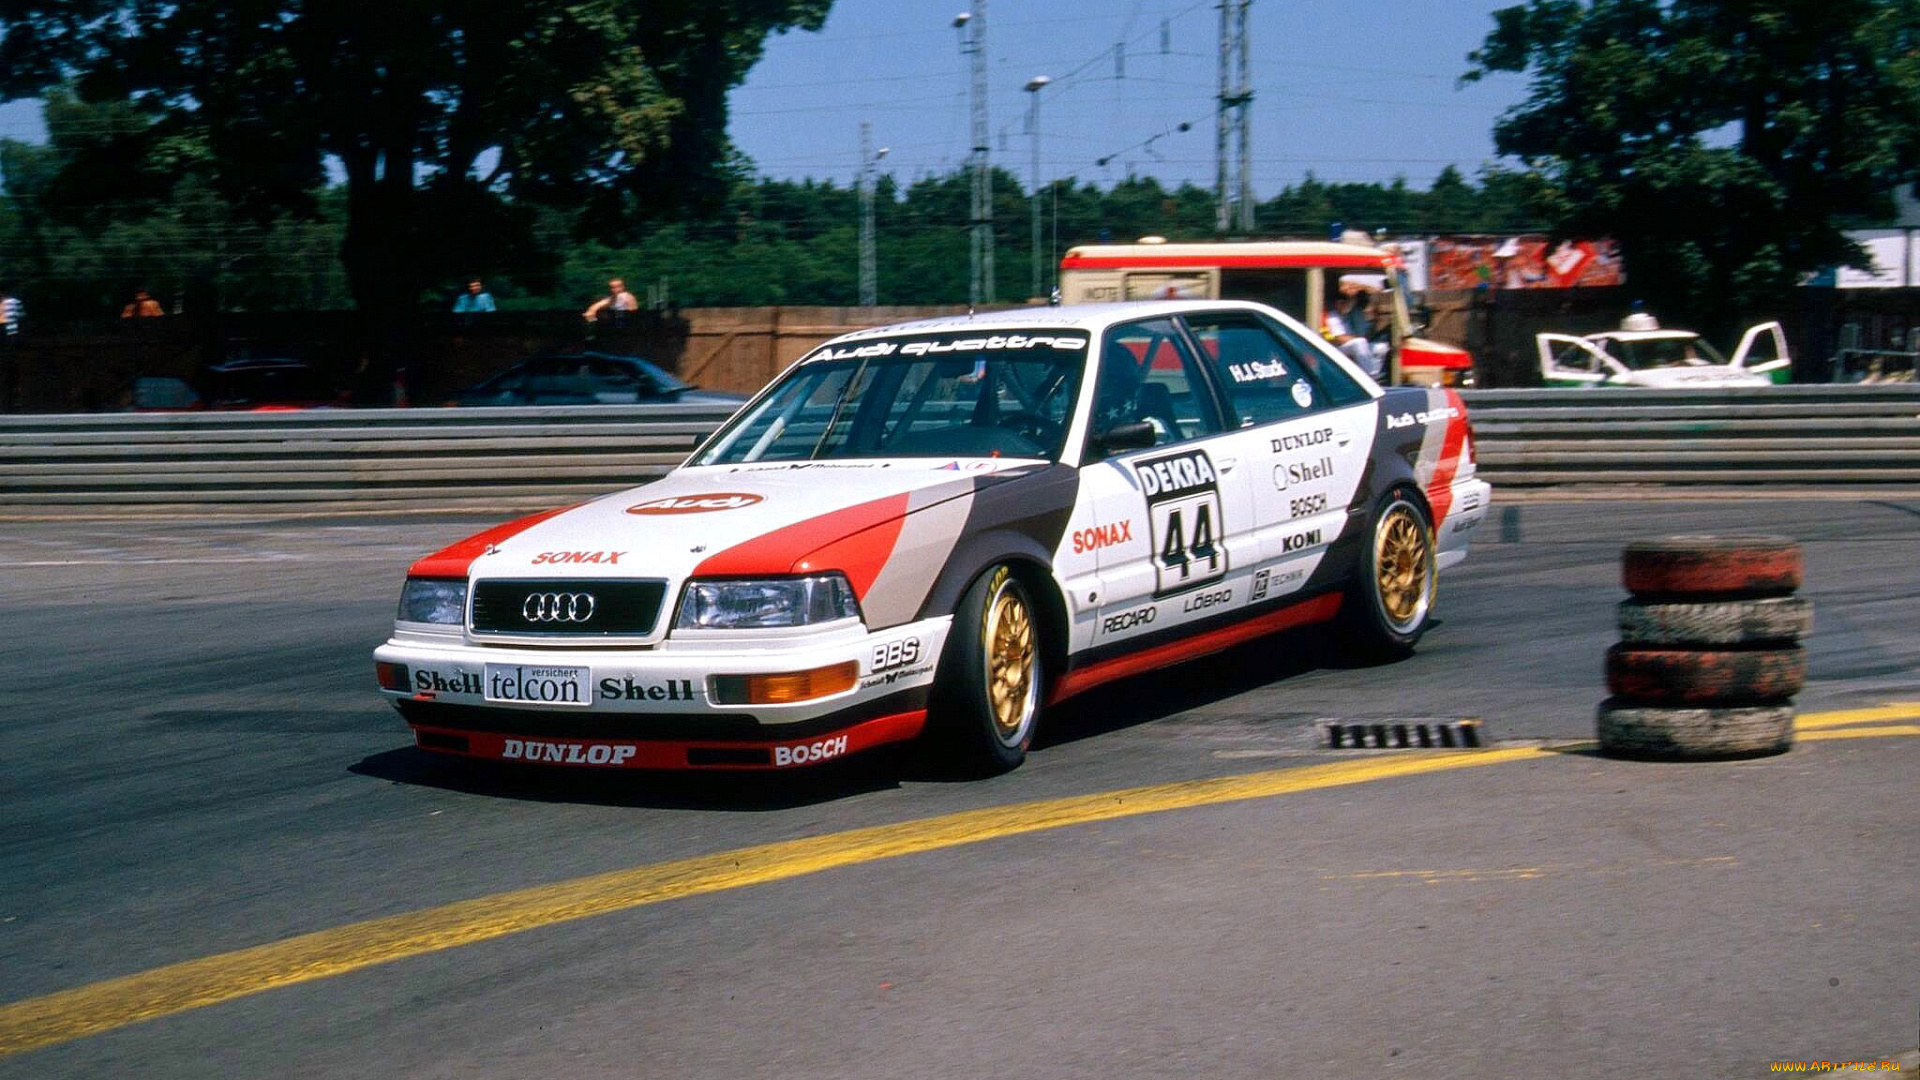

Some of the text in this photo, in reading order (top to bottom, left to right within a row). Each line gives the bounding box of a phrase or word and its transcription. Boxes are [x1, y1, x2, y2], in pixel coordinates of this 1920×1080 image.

[799, 335, 1086, 365] Audi quattro
[1271, 427, 1333, 453] DUNLOP
[1138, 455, 1216, 496] DEKRA
[1289, 456, 1333, 484] Shell
[634, 496, 757, 510] Audi
[1290, 493, 1328, 518] BOSCH
[1073, 520, 1132, 554] SONAX
[1161, 502, 1219, 580] 44
[1282, 529, 1321, 553] KONI
[531, 551, 627, 564] SONAX
[1184, 589, 1232, 613] LÖBRO
[1102, 607, 1157, 634] RECARO
[871, 636, 920, 673] BBS
[415, 670, 483, 694] Shell
[492, 668, 581, 702] telcon
[531, 668, 579, 677] versichert
[600, 677, 695, 701] Shell
[503, 739, 637, 765] DUNLOP
[775, 735, 848, 766] BOSCH
